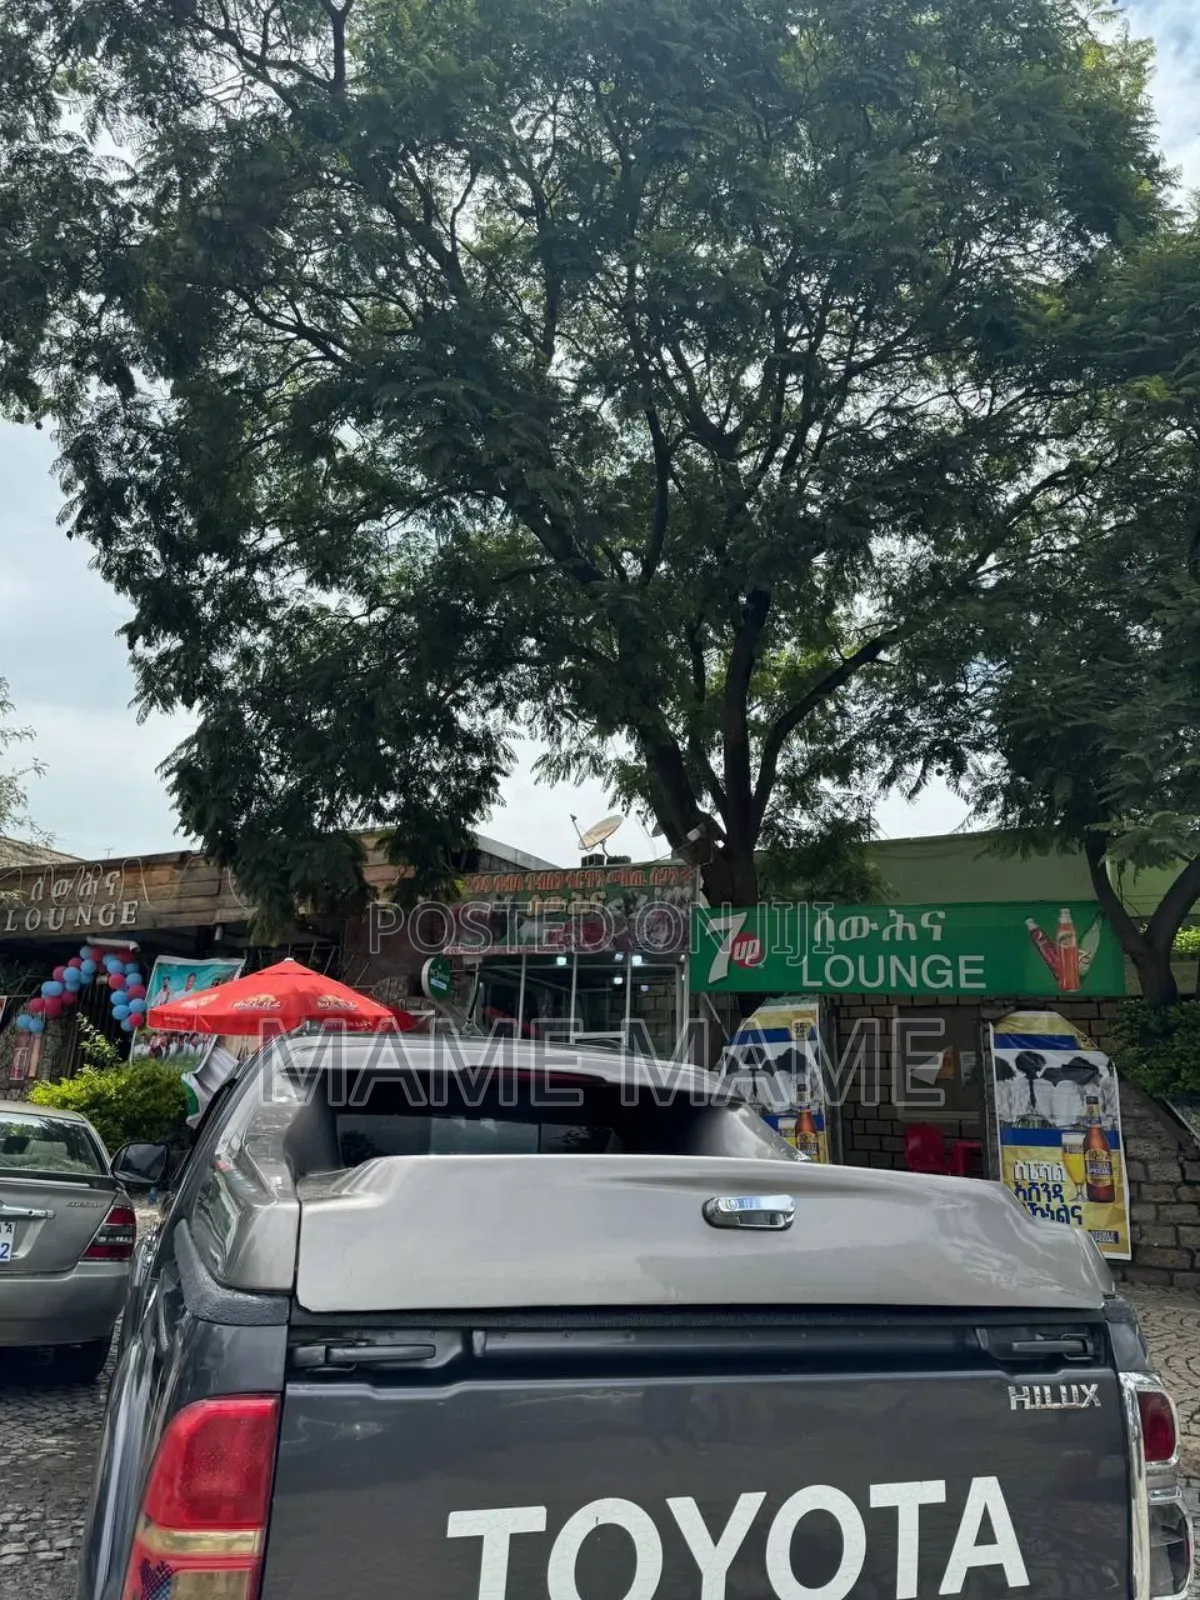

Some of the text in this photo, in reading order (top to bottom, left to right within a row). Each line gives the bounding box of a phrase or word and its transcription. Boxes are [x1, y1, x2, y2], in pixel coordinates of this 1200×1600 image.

[3, 900, 138, 931] LOUNGE
[802, 954, 986, 989] LOUNGE
[1008, 1384, 1100, 1411] HILUX
[447, 1476, 1029, 1600] TOYOTA
